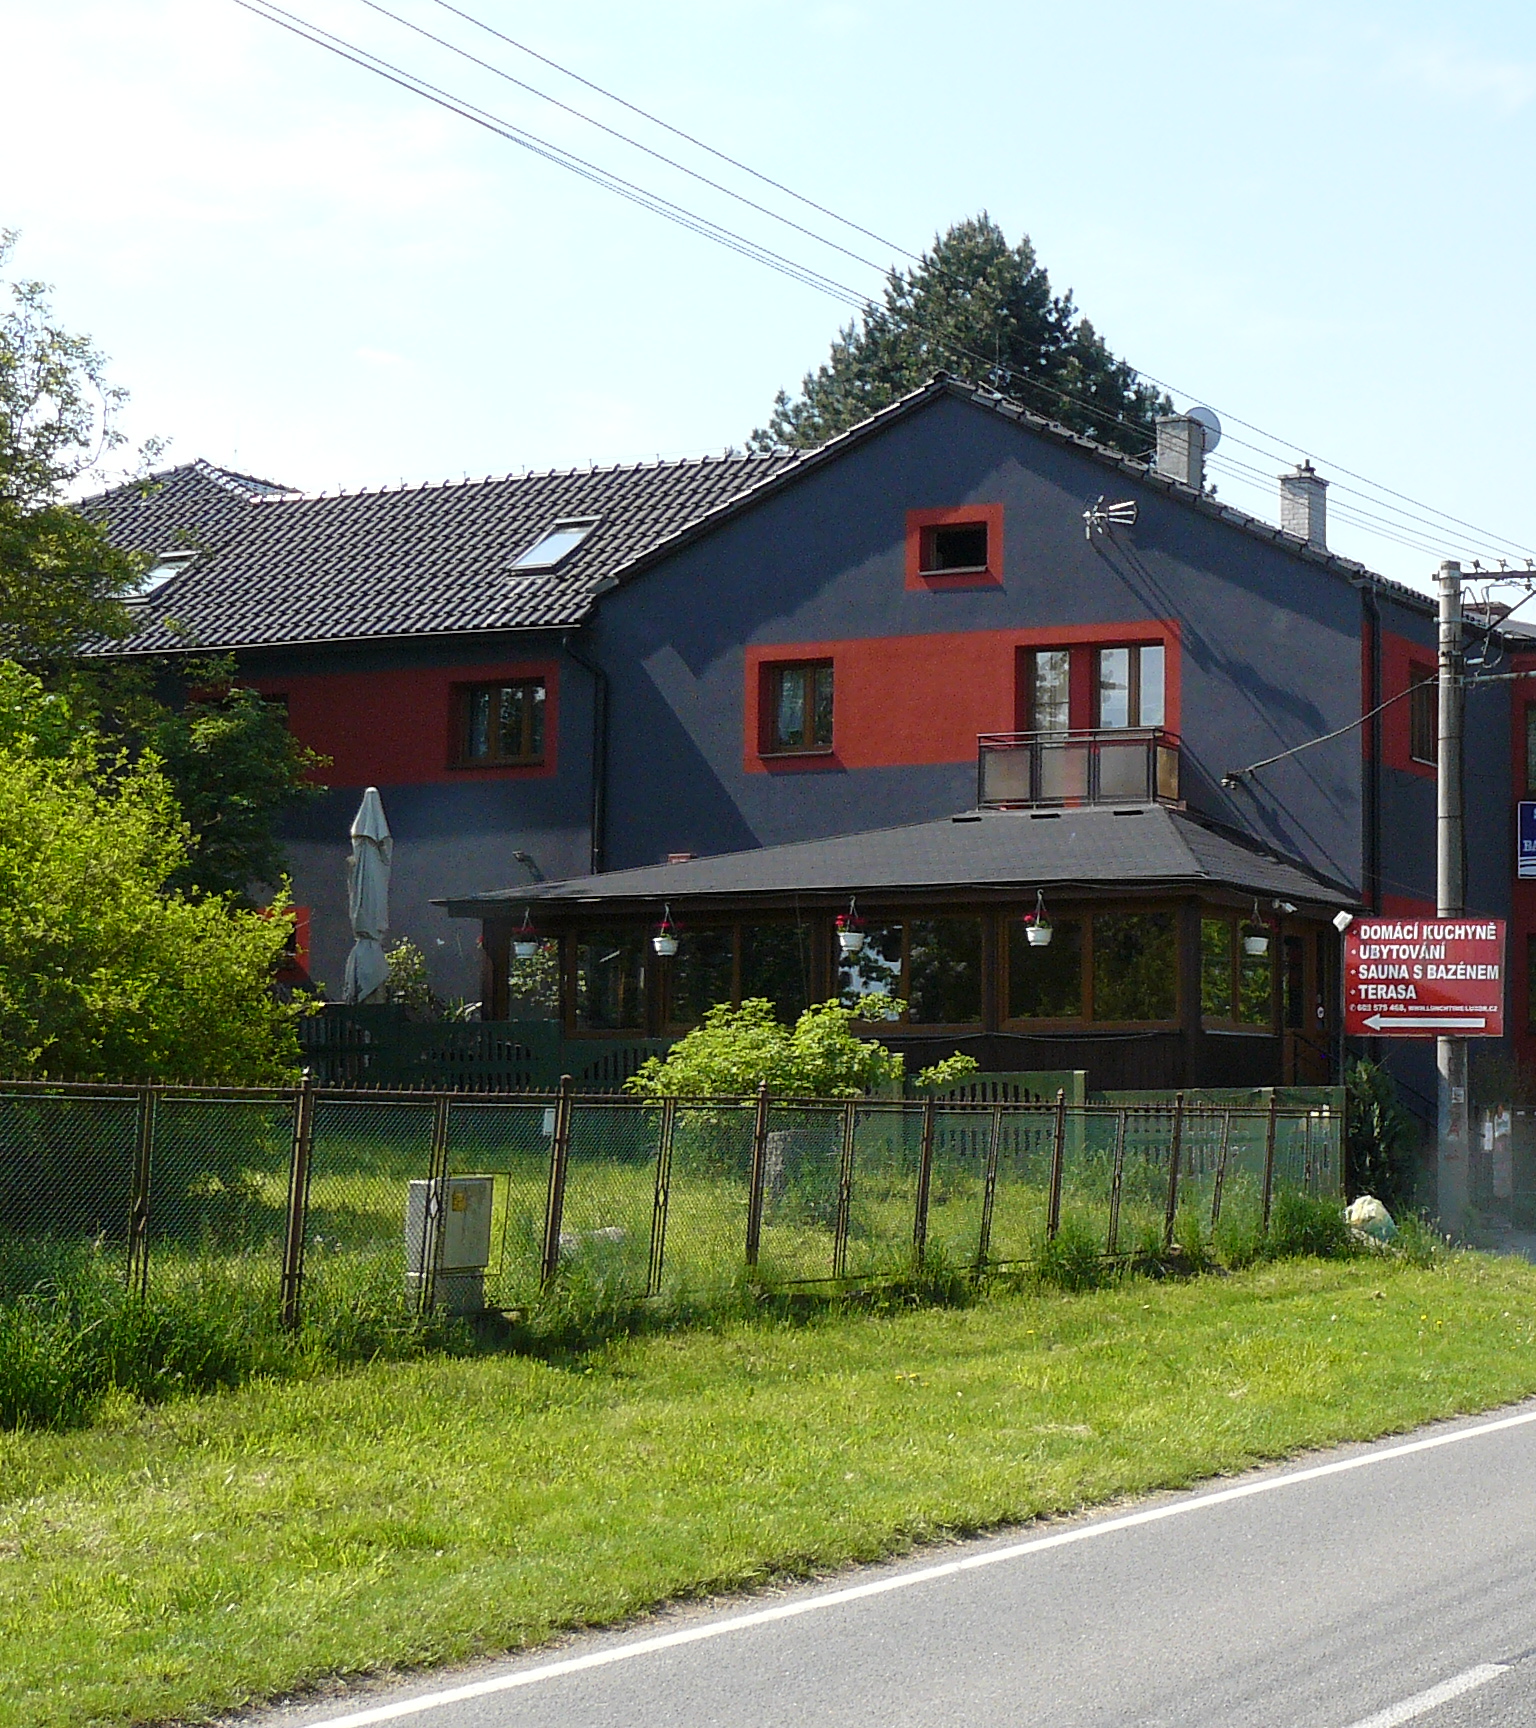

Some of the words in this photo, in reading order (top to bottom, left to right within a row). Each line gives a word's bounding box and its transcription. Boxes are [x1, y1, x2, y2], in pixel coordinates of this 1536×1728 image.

[1360, 921, 1419, 940] DOMÁCÍ
[1423, 921, 1497, 940] KUCHYNĚ
[1359, 941, 1446, 960] UBYTOVÁNÍ
[1358, 964, 1409, 979] SAUNA
[1413, 964, 1423, 979] S
[1427, 960, 1499, 980] BAZÉNEM
[1358, 984, 1417, 1000] TERASA
